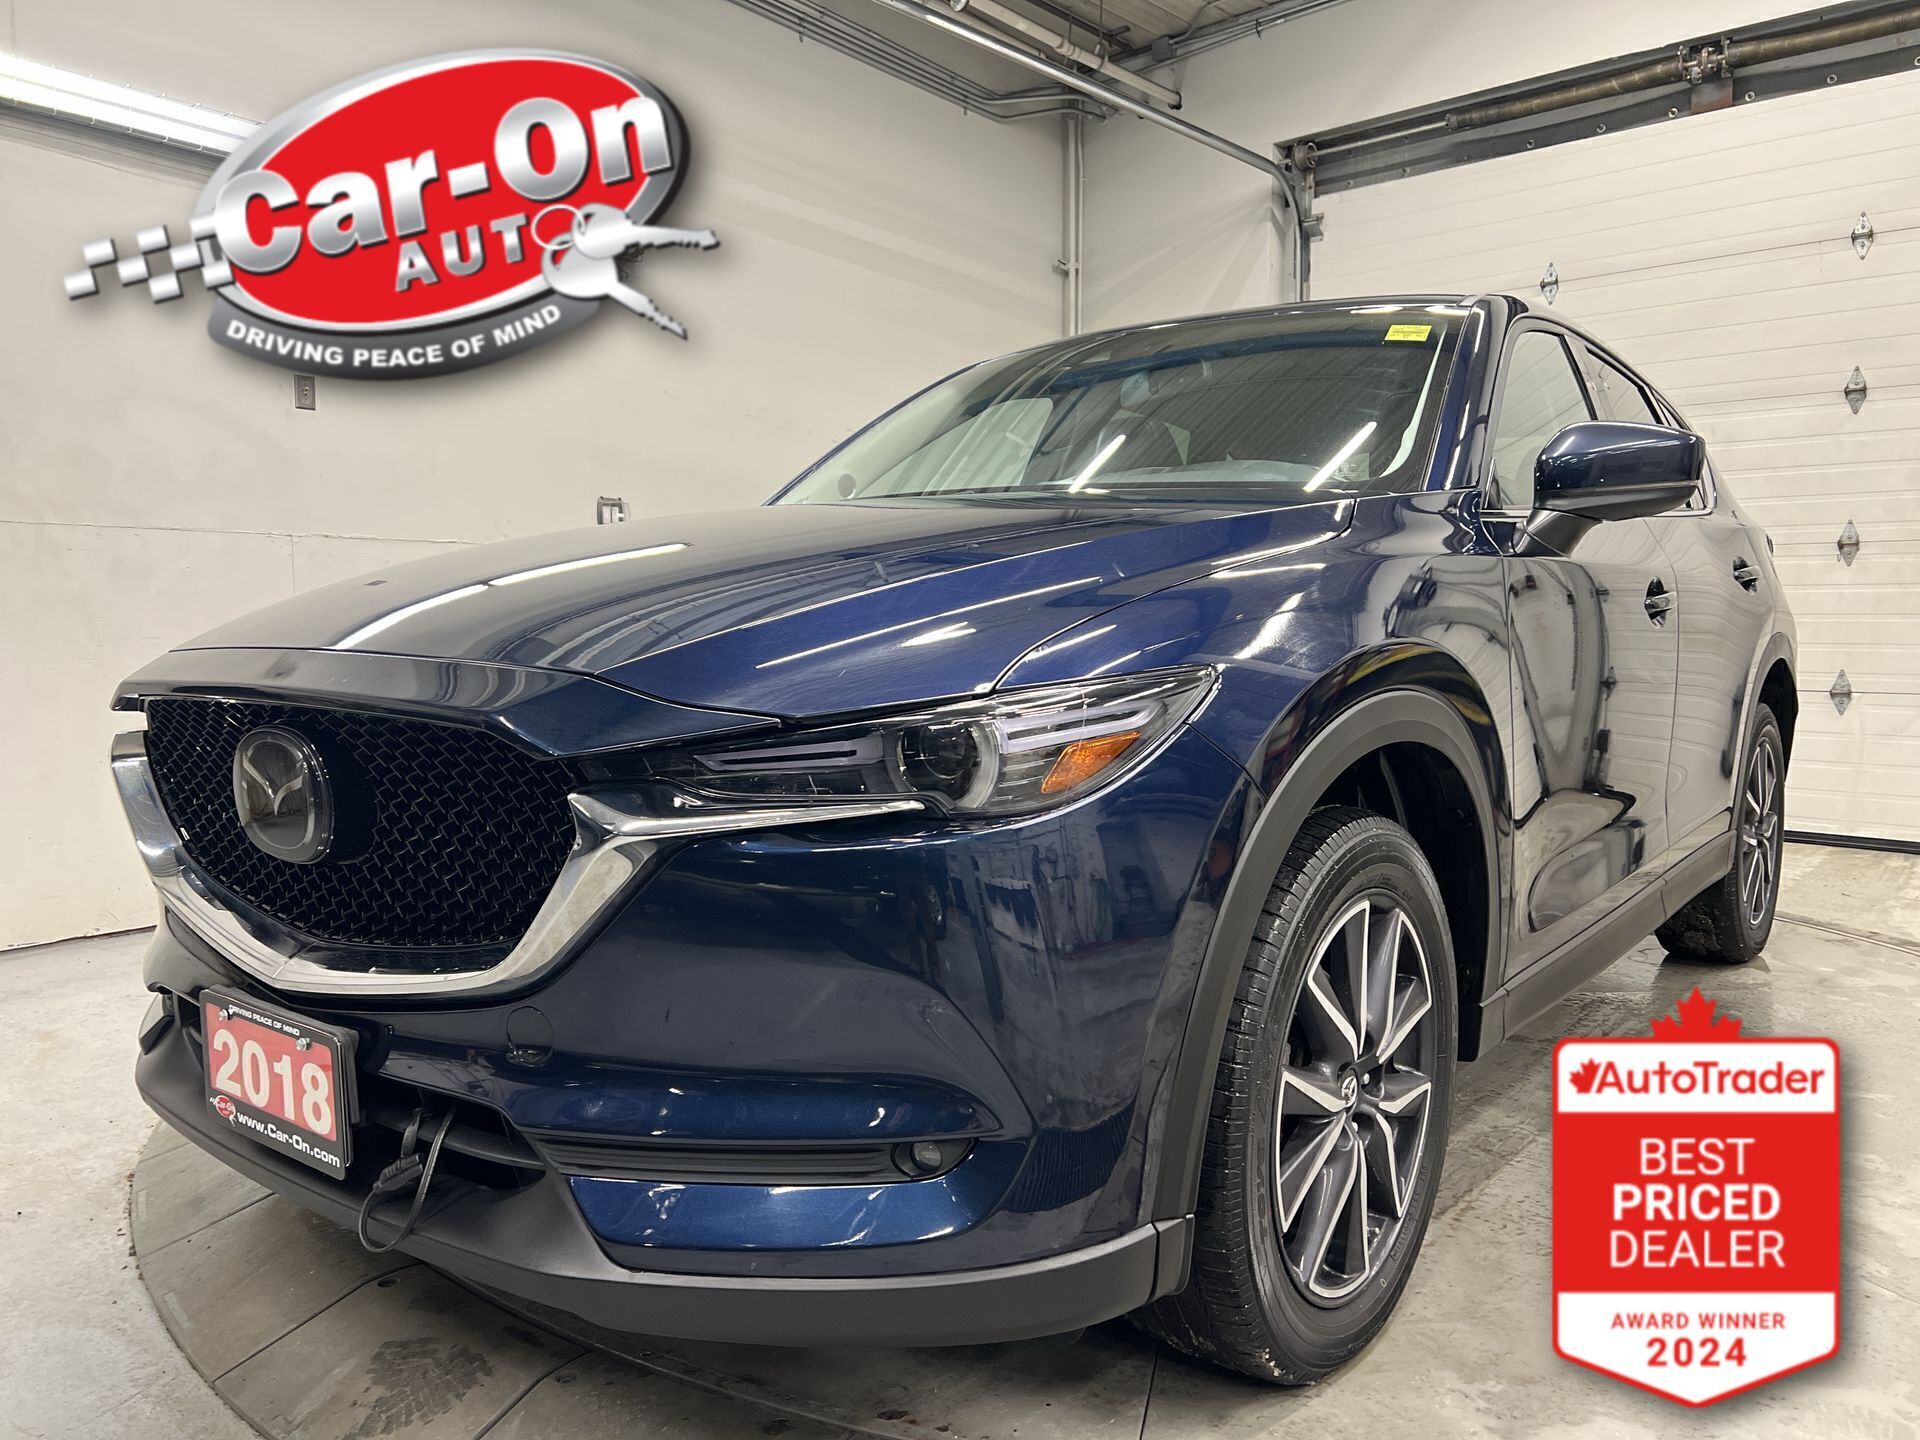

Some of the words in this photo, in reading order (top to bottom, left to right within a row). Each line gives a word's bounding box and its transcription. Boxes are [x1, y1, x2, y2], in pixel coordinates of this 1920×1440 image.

[252, 1013, 273, 1027] PEACE
[273, 1020, 283, 1030] OF
[282, 1024, 300, 1037] MIND
[213, 1028, 331, 1136] 2018
[236, 1111, 341, 1168] www.Car-On.com
